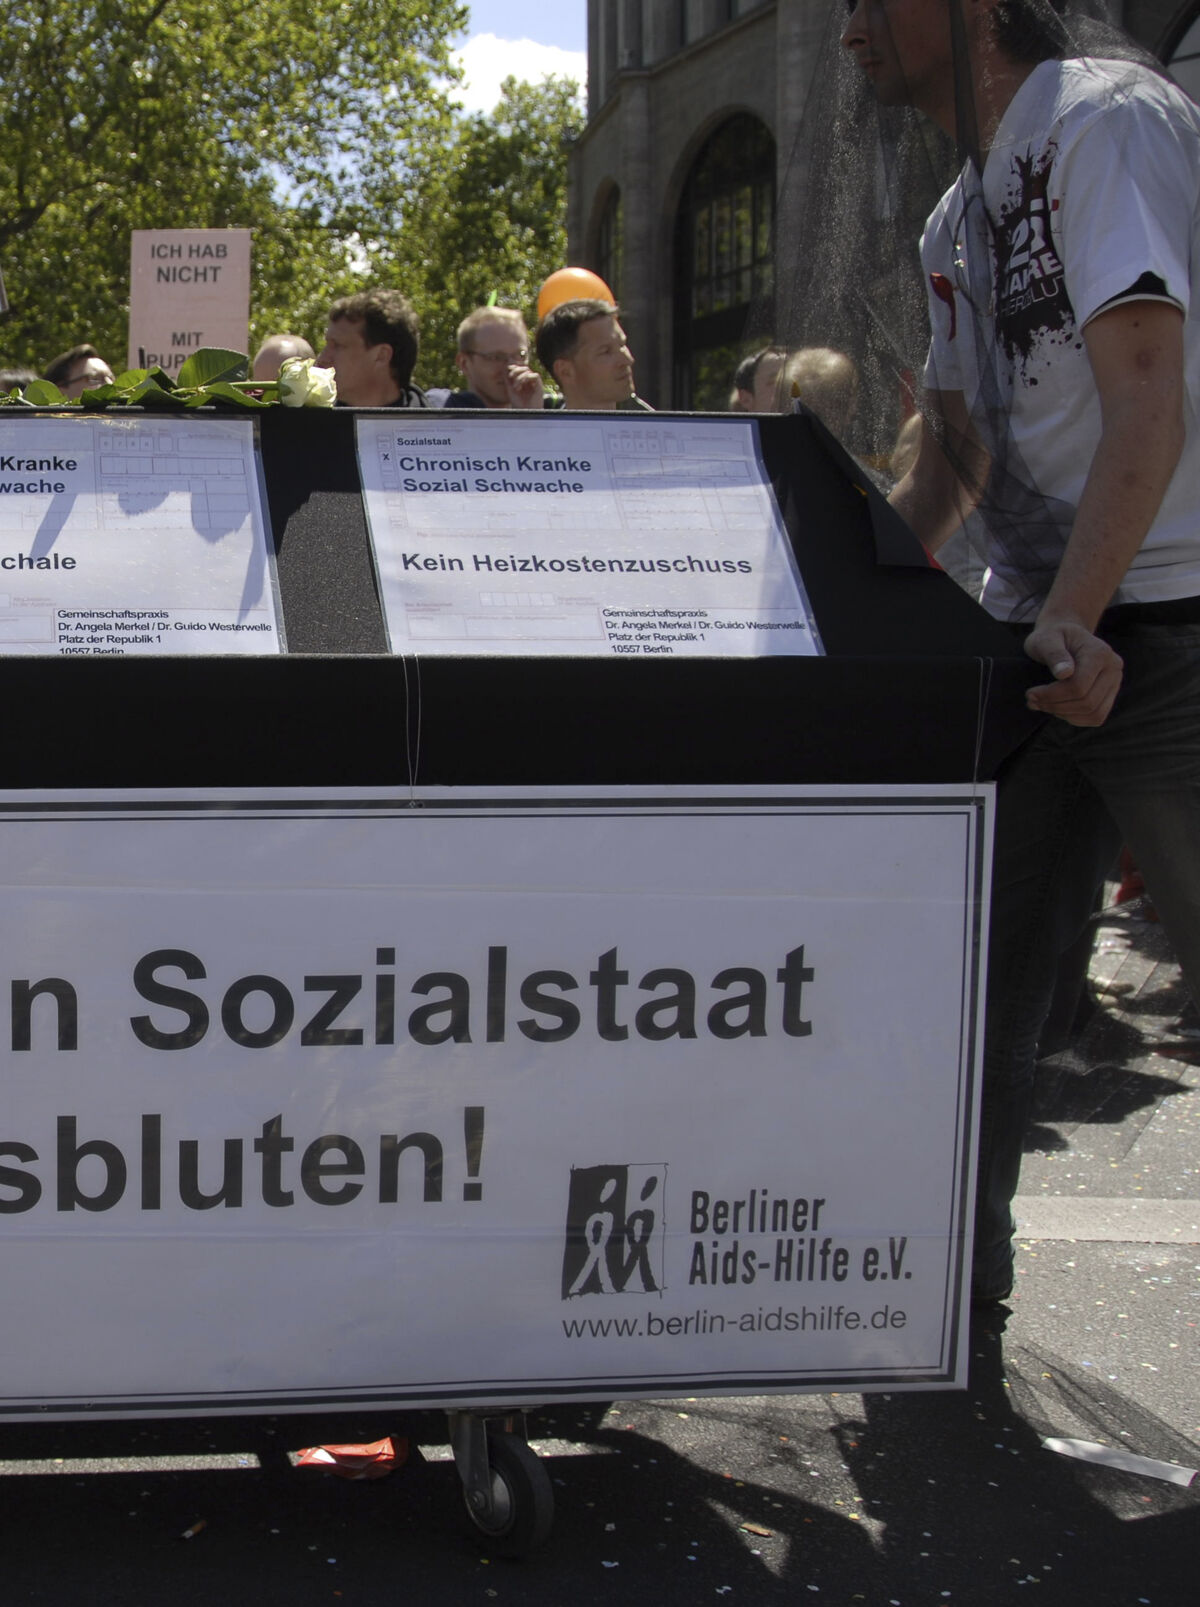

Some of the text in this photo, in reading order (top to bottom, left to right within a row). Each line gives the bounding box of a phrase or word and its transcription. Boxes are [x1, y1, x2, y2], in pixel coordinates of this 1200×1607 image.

[151, 244, 228, 259] ICH HAB
[157, 266, 222, 283] NICHT
[171, 331, 204, 347] MIT
[146, 353, 188, 370] PUP
[397, 437, 452, 446] Sozialstaat
[0, 456, 78, 471] Kranke
[400, 456, 592, 472] Chronisch Kranke
[403, 478, 585, 493] Sozial Schwache
[402, 553, 753, 574] Kein Heizkostenzuschuss
[58, 609, 169, 620] Gemeinschaftspraxis
[602, 608, 708, 618] Gemeinschaftspraxis
[58, 622, 73, 631] Dr.
[75, 622, 112, 633] Angela
[114, 622, 150, 631] Merkel
[157, 622, 172, 631] Dr.
[174, 622, 207, 631] Guido
[208, 622, 272, 632] Westerwelle
[605, 621, 620, 629] Dr.
[622, 621, 657, 631] Angela
[659, 621, 692, 630] Merkel
[699, 621, 713, 629] Dr.
[715, 621, 745, 630] Guido
[747, 621, 806, 630] Westerwelle
[59, 635, 84, 644] Platz
[86, 635, 105, 644] der
[106, 635, 154, 645] Republik
[608, 633, 633, 641] Platz
[635, 633, 651, 641] der
[653, 632, 697, 643] Republik
[611, 645, 673, 653] 10557 Berlin
[130, 945, 814, 1050] Sozialstaat
[690, 1189, 826, 1235] Berliner
[688, 1237, 913, 1285] Aids-Hilfe e.V.
[562, 1305, 907, 1338] www.berlin-aidshilfe.de
